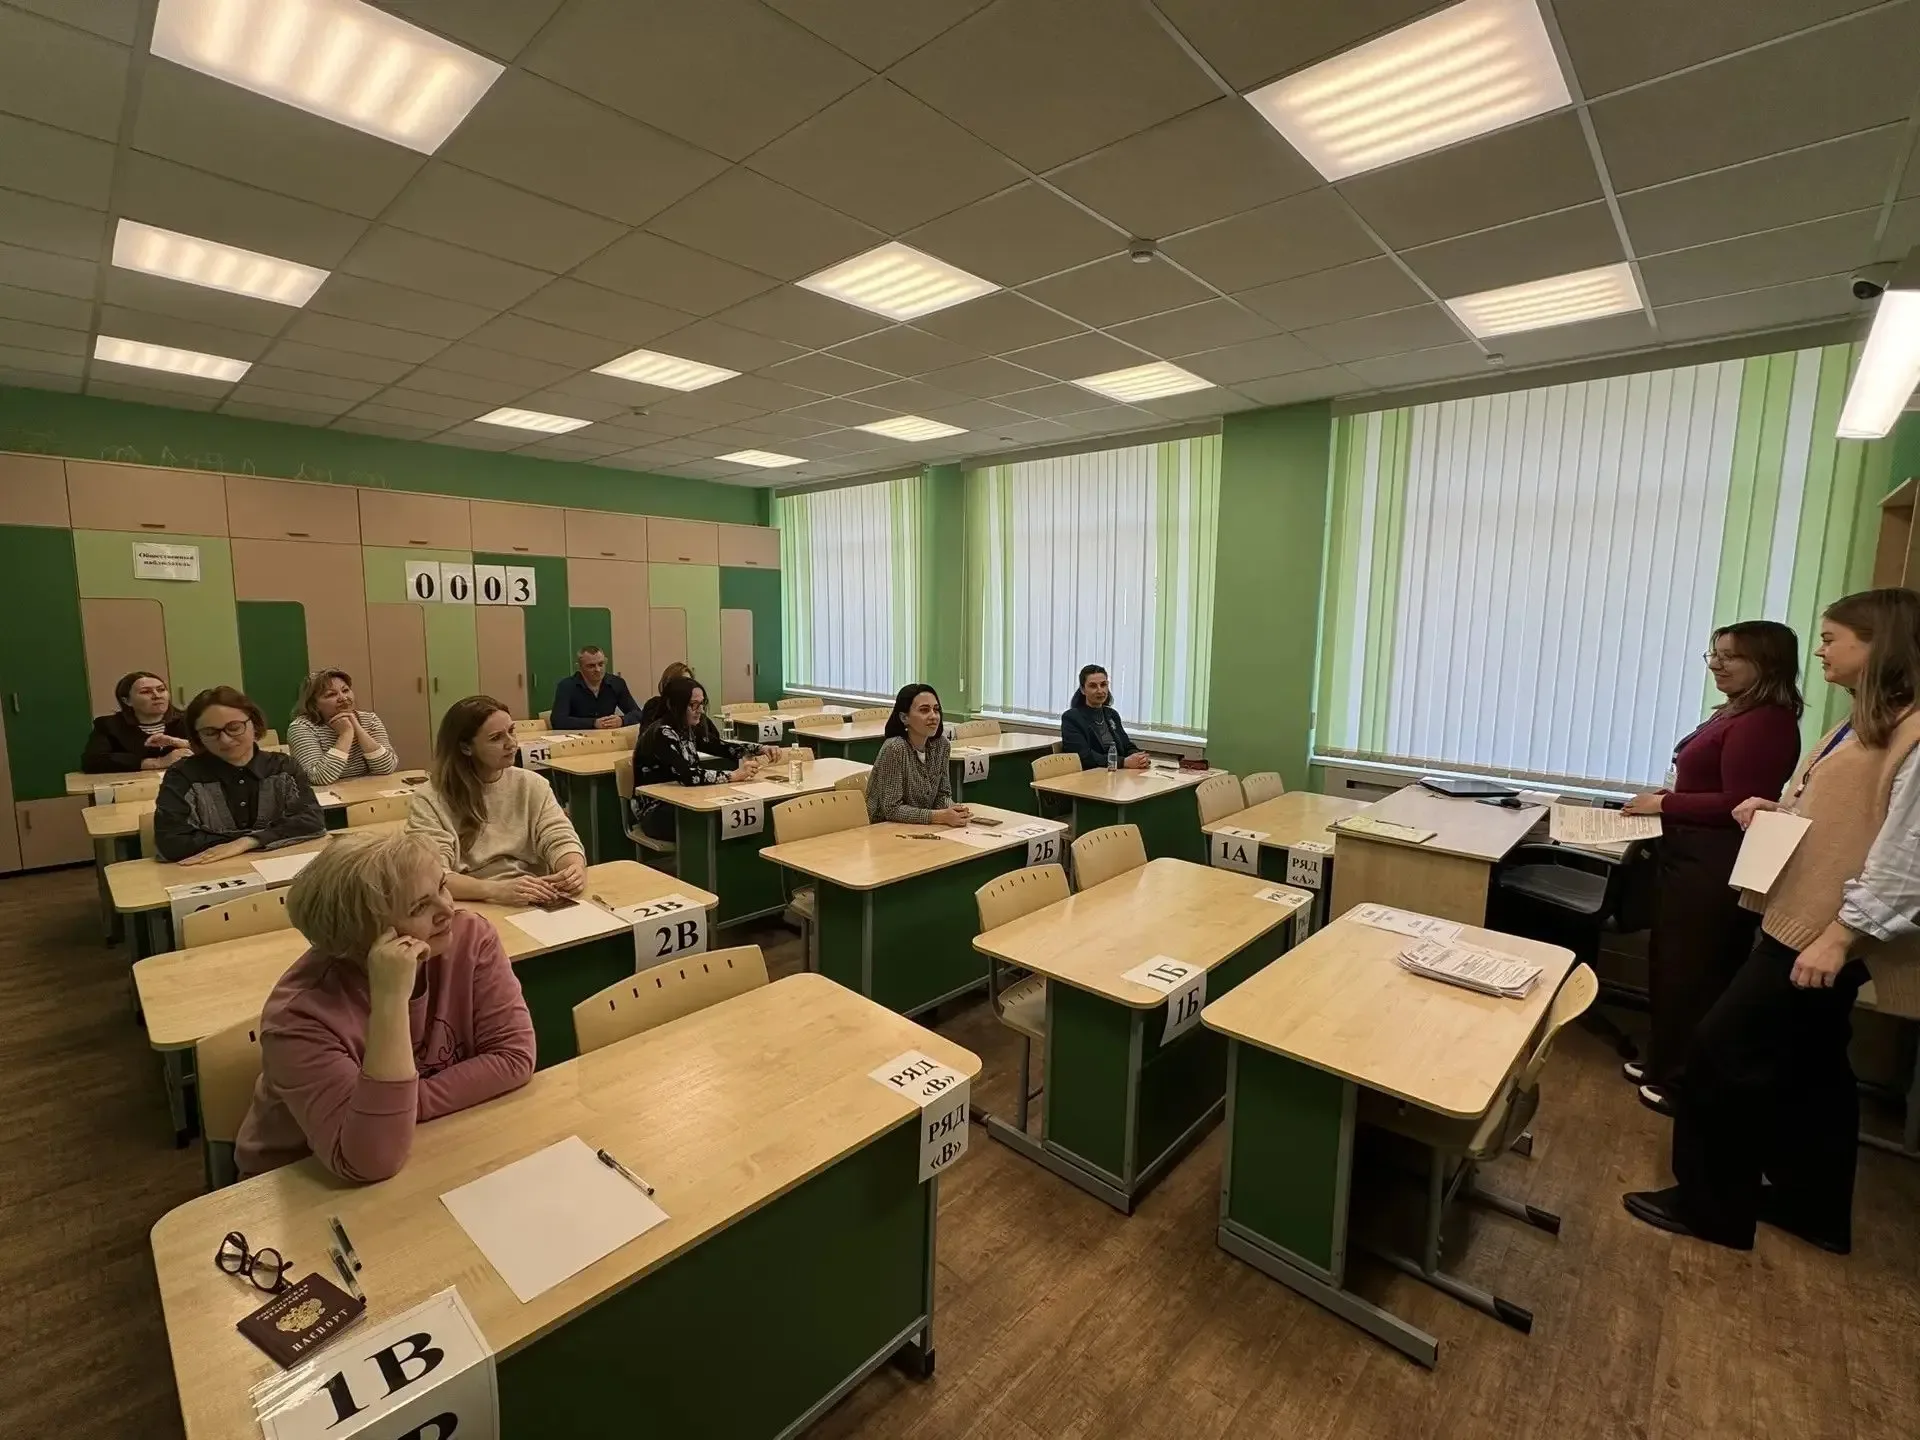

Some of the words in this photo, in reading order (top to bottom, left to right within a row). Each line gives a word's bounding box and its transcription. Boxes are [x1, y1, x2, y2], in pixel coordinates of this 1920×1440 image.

[763, 725, 780, 737] 5А
[968, 759, 985, 776] 3А
[730, 806, 757, 829] 3Б
[1033, 839, 1054, 863] 2Б
[1220, 841, 1249, 864] 1А
[1291, 857, 1319, 873] РЯД
[1291, 874, 1316, 886] «А»
[632, 901, 684, 918] 2В
[655, 920, 699, 957] 2В
[1147, 962, 1189, 984] 1Б
[1173, 986, 1200, 1026] 1Б
[888, 1059, 940, 1089] РЯД
[922, 1075, 955, 1096] «В»
[928, 1103, 965, 1144] РЯД
[929, 1141, 962, 1169] «В»
[291, 1308, 349, 1352] ПАСПОРТ
[316, 1332, 446, 1430] 1В
